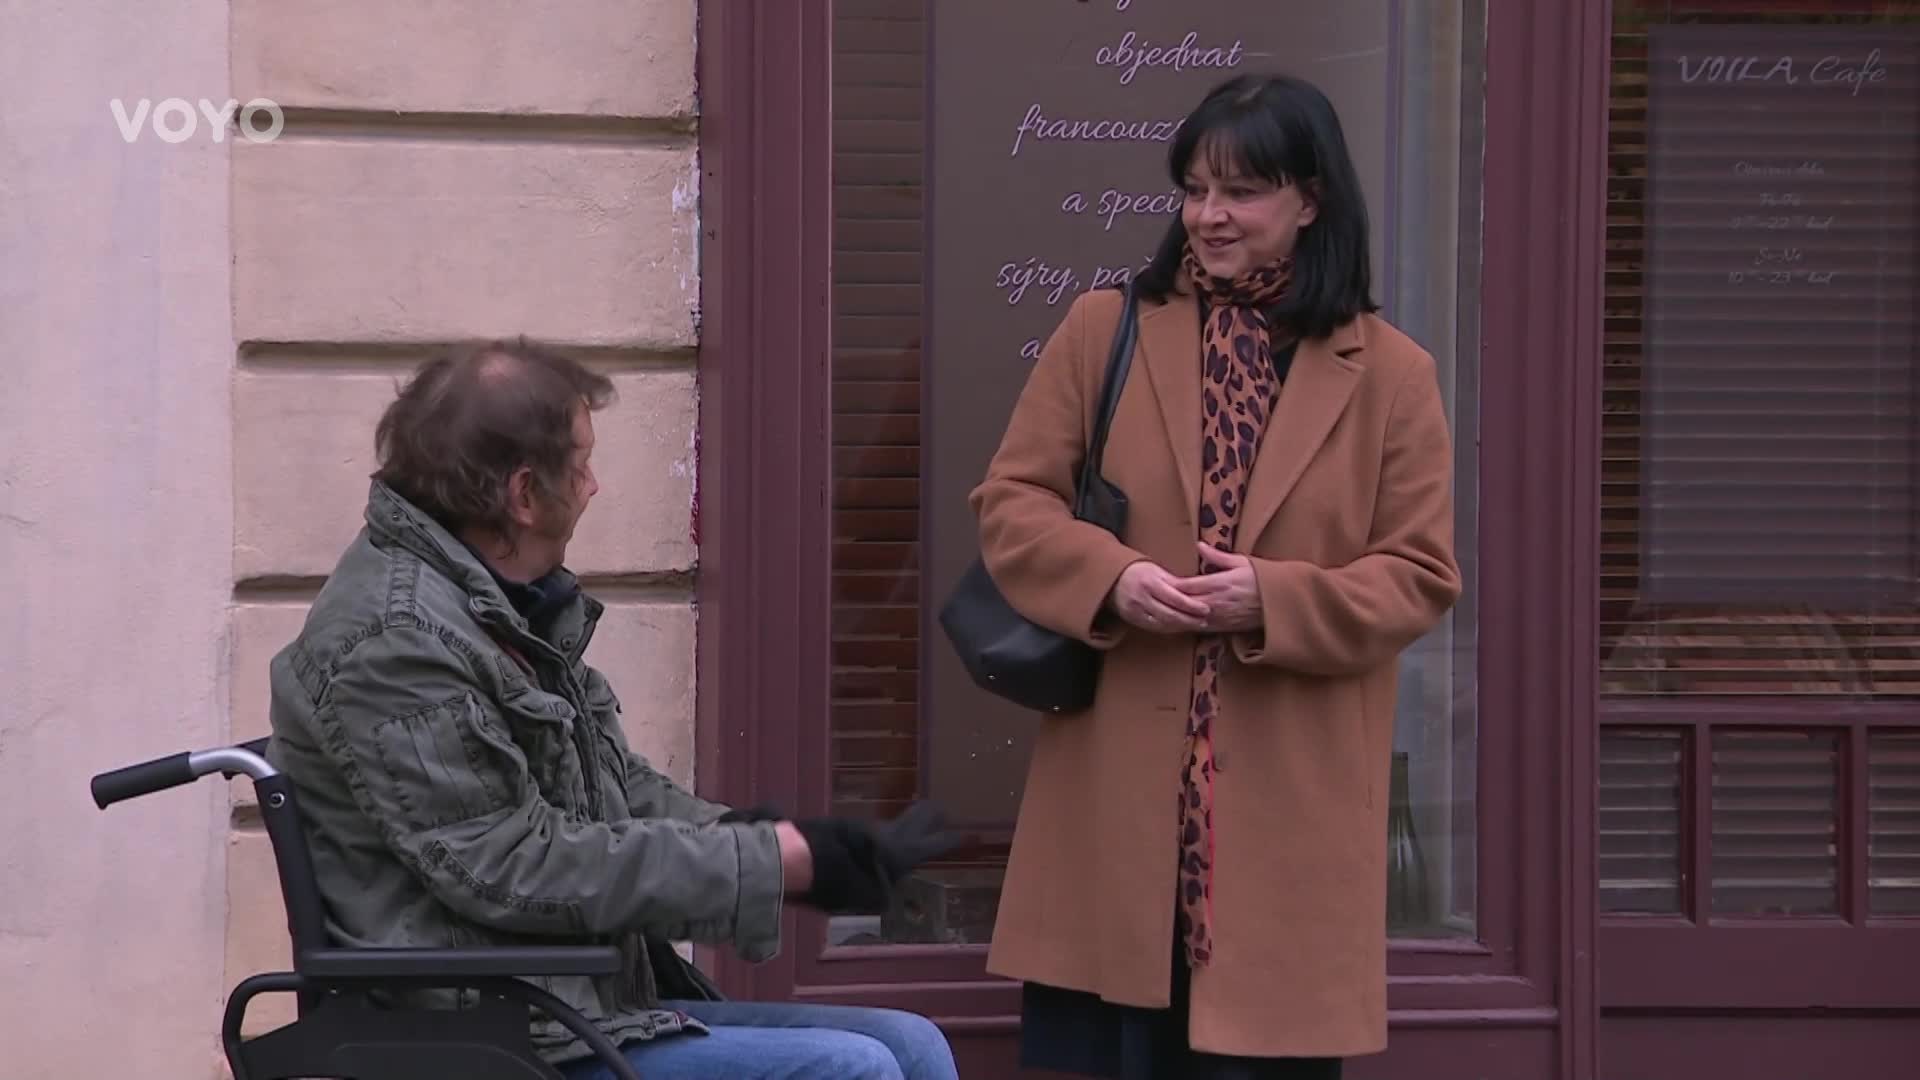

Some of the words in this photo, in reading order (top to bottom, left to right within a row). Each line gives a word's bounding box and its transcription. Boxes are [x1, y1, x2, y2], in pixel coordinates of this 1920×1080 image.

[1096, 31, 1242, 84] objednat
[1011, 103, 1187, 156] francouz
[1062, 193, 1087, 214] a
[1097, 189, 1183, 231] speci
[996, 257, 1081, 305] sýry,
[1090, 256, 1152, 292] pa
